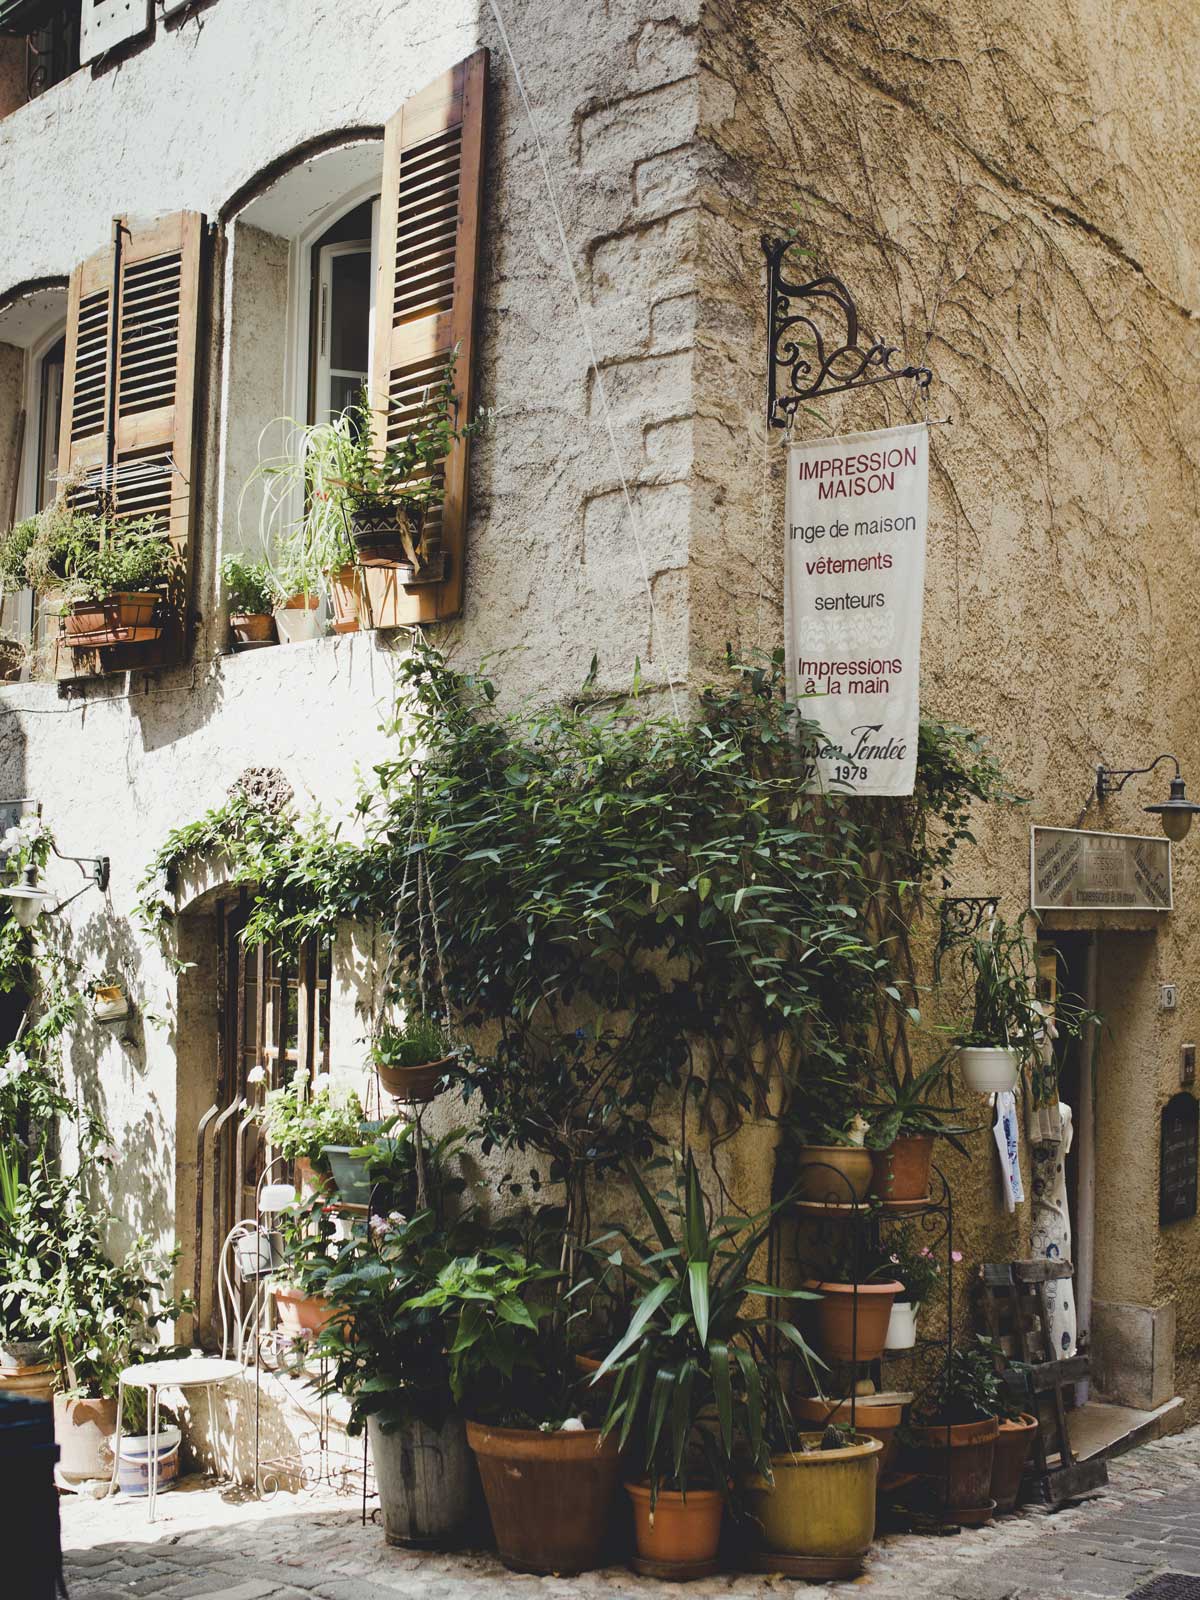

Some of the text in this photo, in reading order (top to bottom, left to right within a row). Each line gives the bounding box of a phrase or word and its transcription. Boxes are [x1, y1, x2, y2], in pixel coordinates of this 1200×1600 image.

[799, 446, 917, 481] IMPRESSION
[818, 472, 895, 500] MAISON
[829, 520, 849, 538] de
[854, 516, 916, 536] maison
[806, 552, 893, 575] vêtements
[814, 592, 885, 611] senteurs
[799, 657, 902, 680] Impressions
[804, 676, 889, 694] à la main
[848, 724, 907, 760] Fondée
[835, 766, 868, 781] 1978
[1166, 990, 1172, 1005] 9
